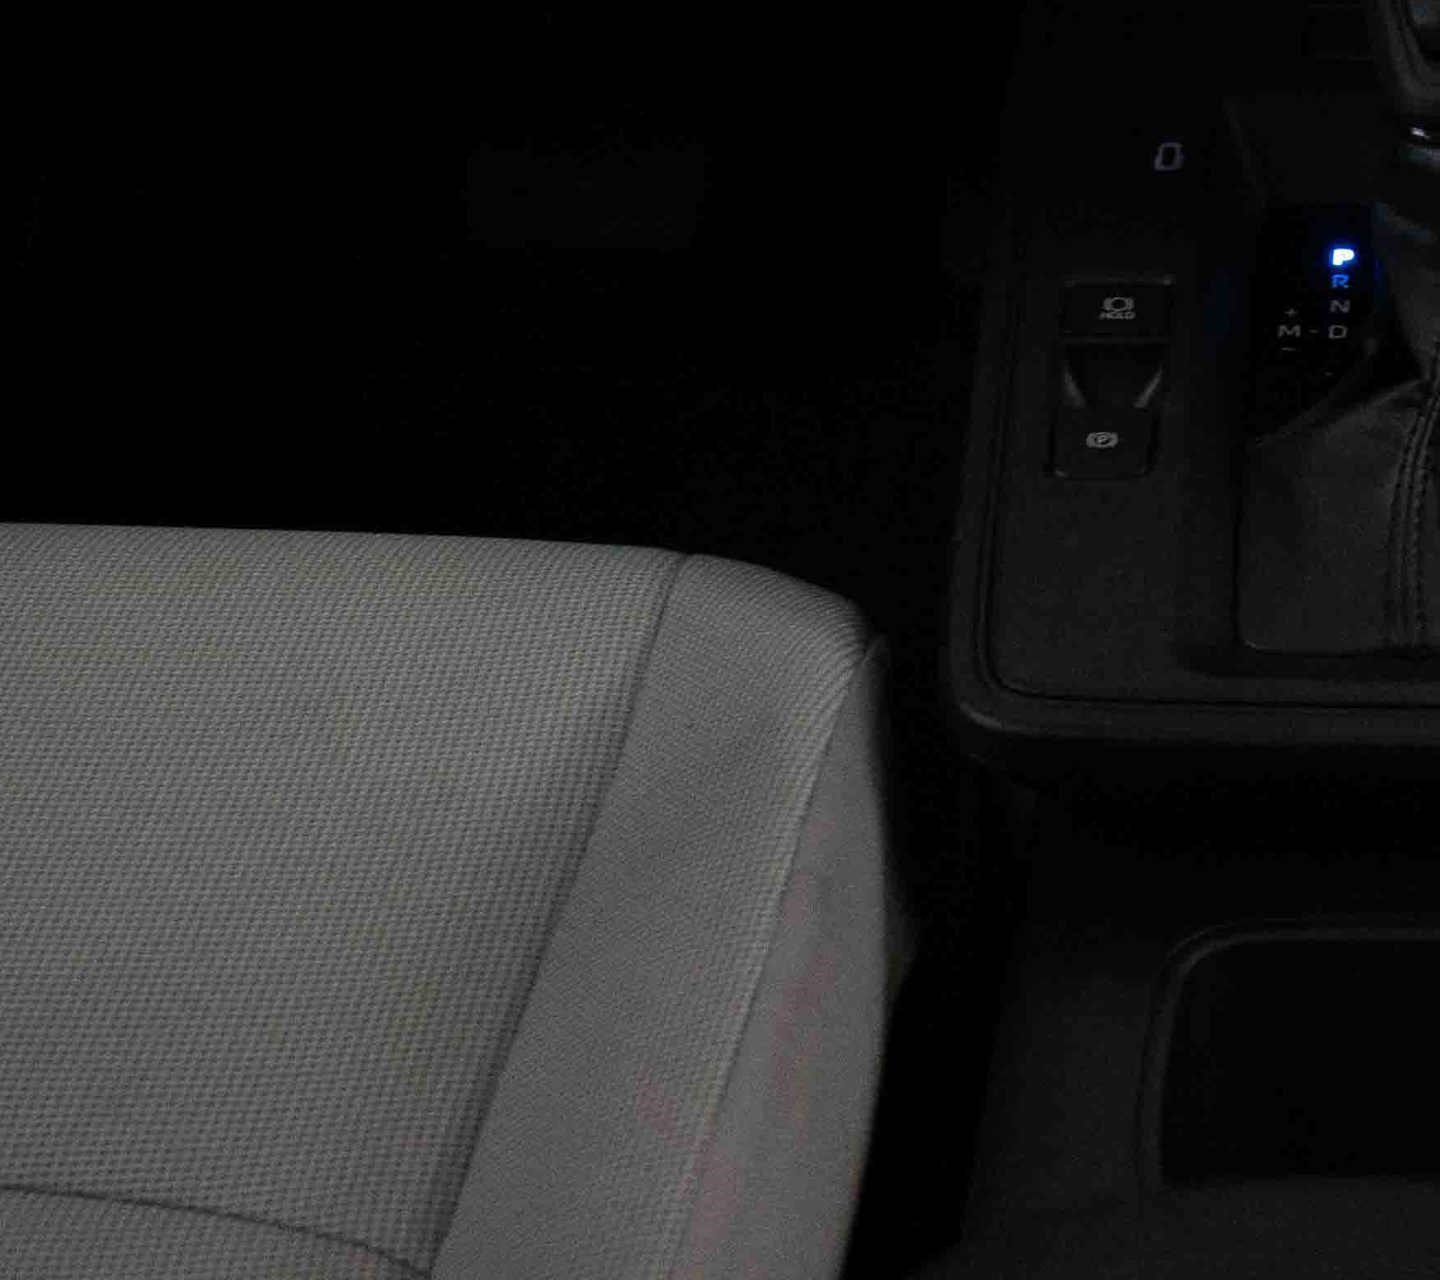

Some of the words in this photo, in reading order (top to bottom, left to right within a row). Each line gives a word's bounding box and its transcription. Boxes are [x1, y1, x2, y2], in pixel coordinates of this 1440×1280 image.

[1329, 247, 1355, 267] P
[1331, 273, 1350, 289] R
[1330, 298, 1350, 313] N
[1278, 324, 1302, 338] M
[1328, 325, 1349, 339] D
